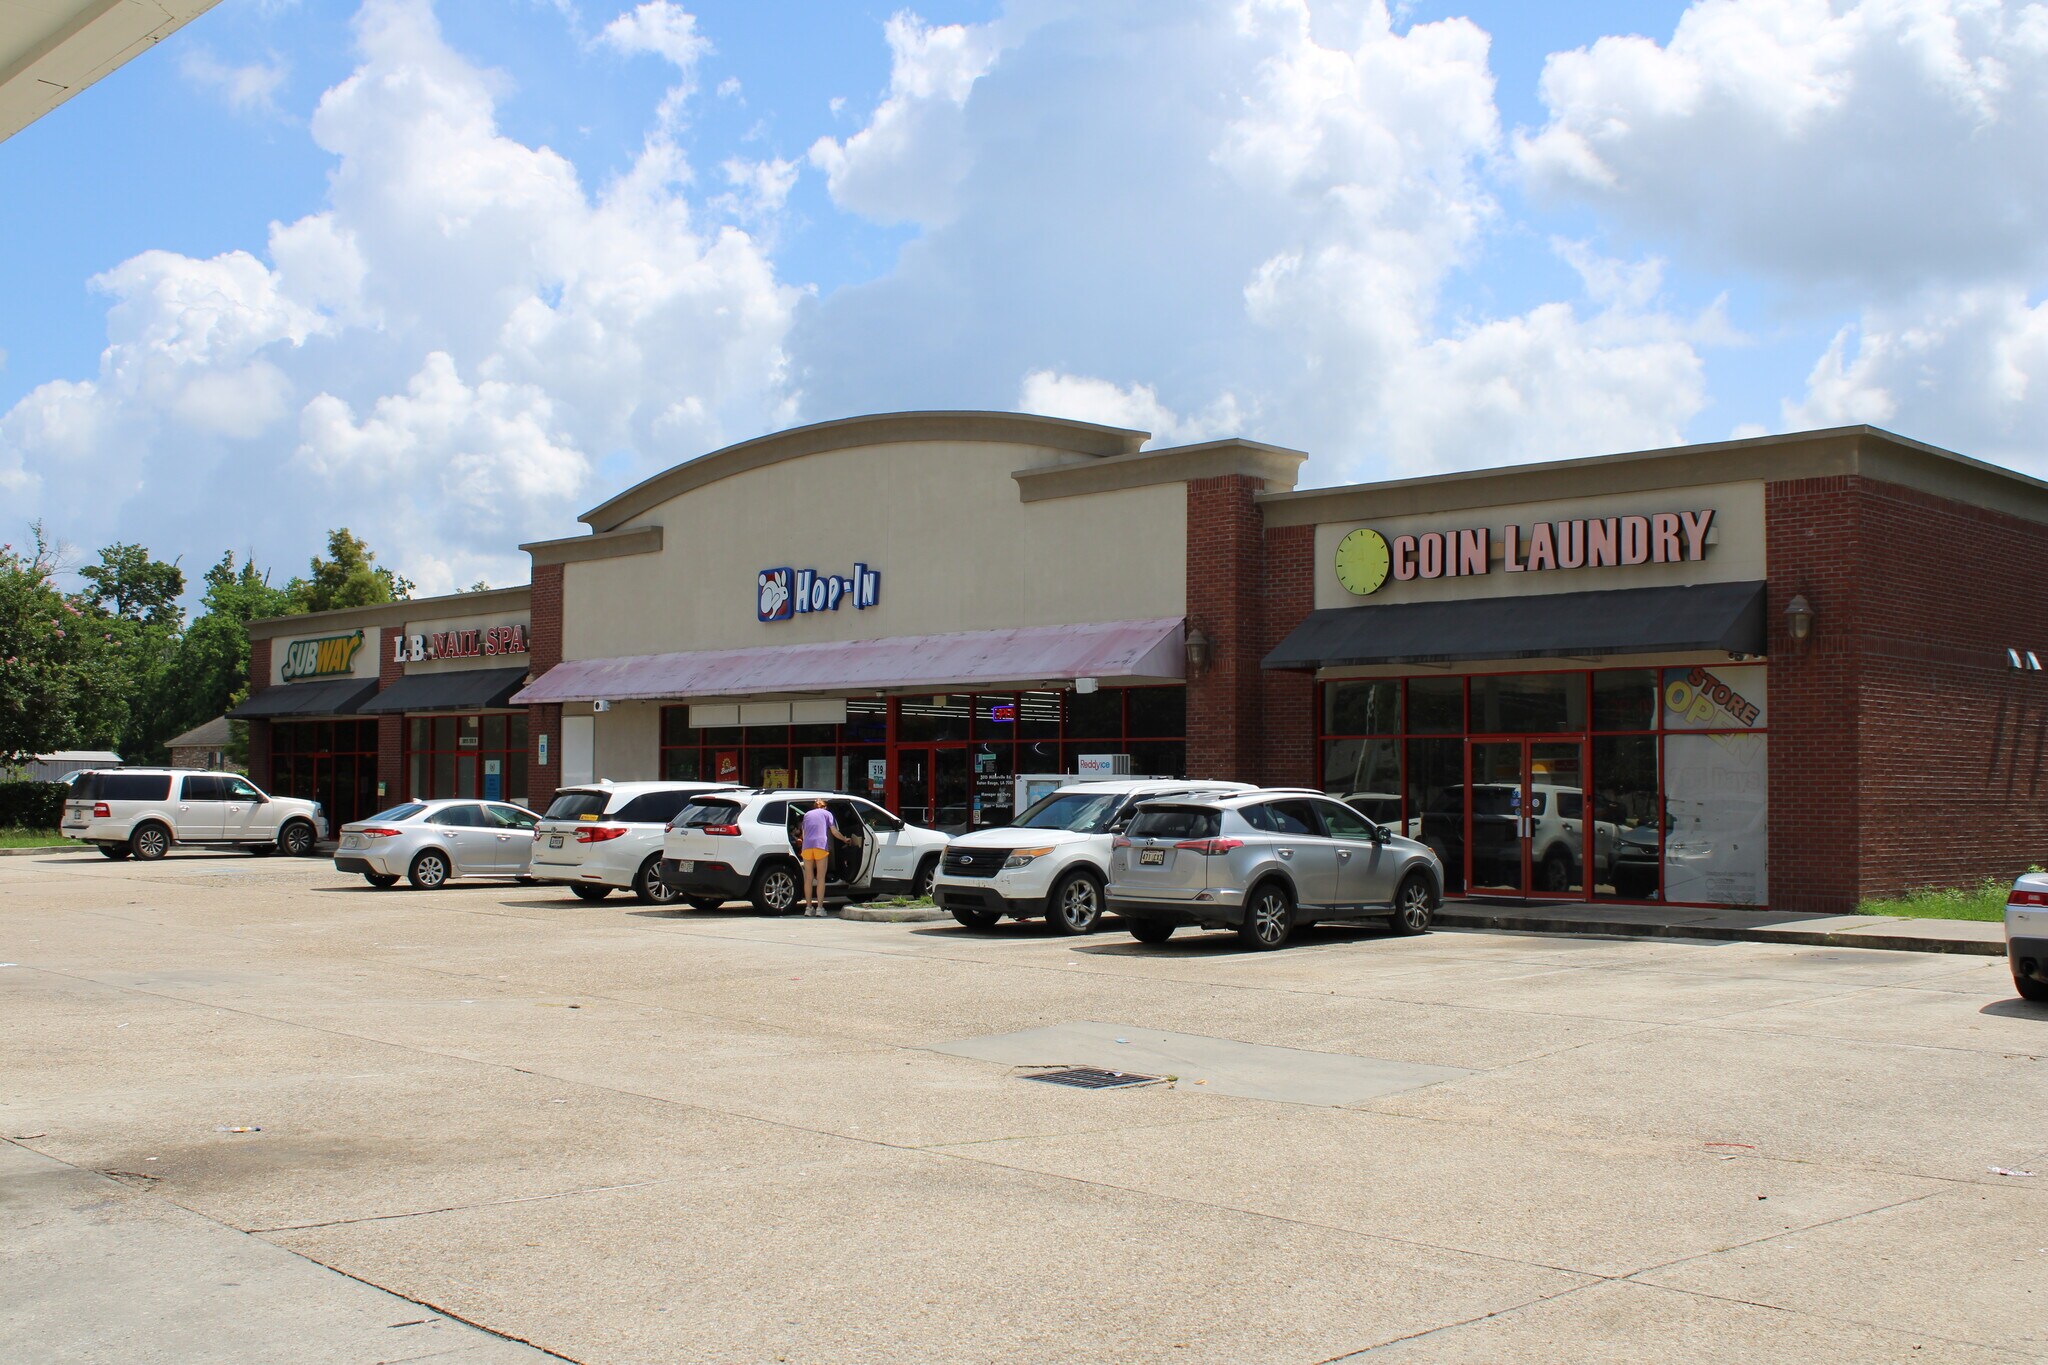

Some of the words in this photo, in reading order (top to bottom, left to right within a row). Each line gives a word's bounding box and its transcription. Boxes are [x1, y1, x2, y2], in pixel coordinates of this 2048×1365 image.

[1393, 528, 1490, 581] COIN
[1504, 509, 1716, 572] LAUNDRY
[283, 632, 362, 680] SUBWAY
[394, 634, 428, 663] L.B.
[432, 629, 483, 659] NAIL
[486, 624, 527, 656] SPA
[1687, 667, 1760, 727] STORE
